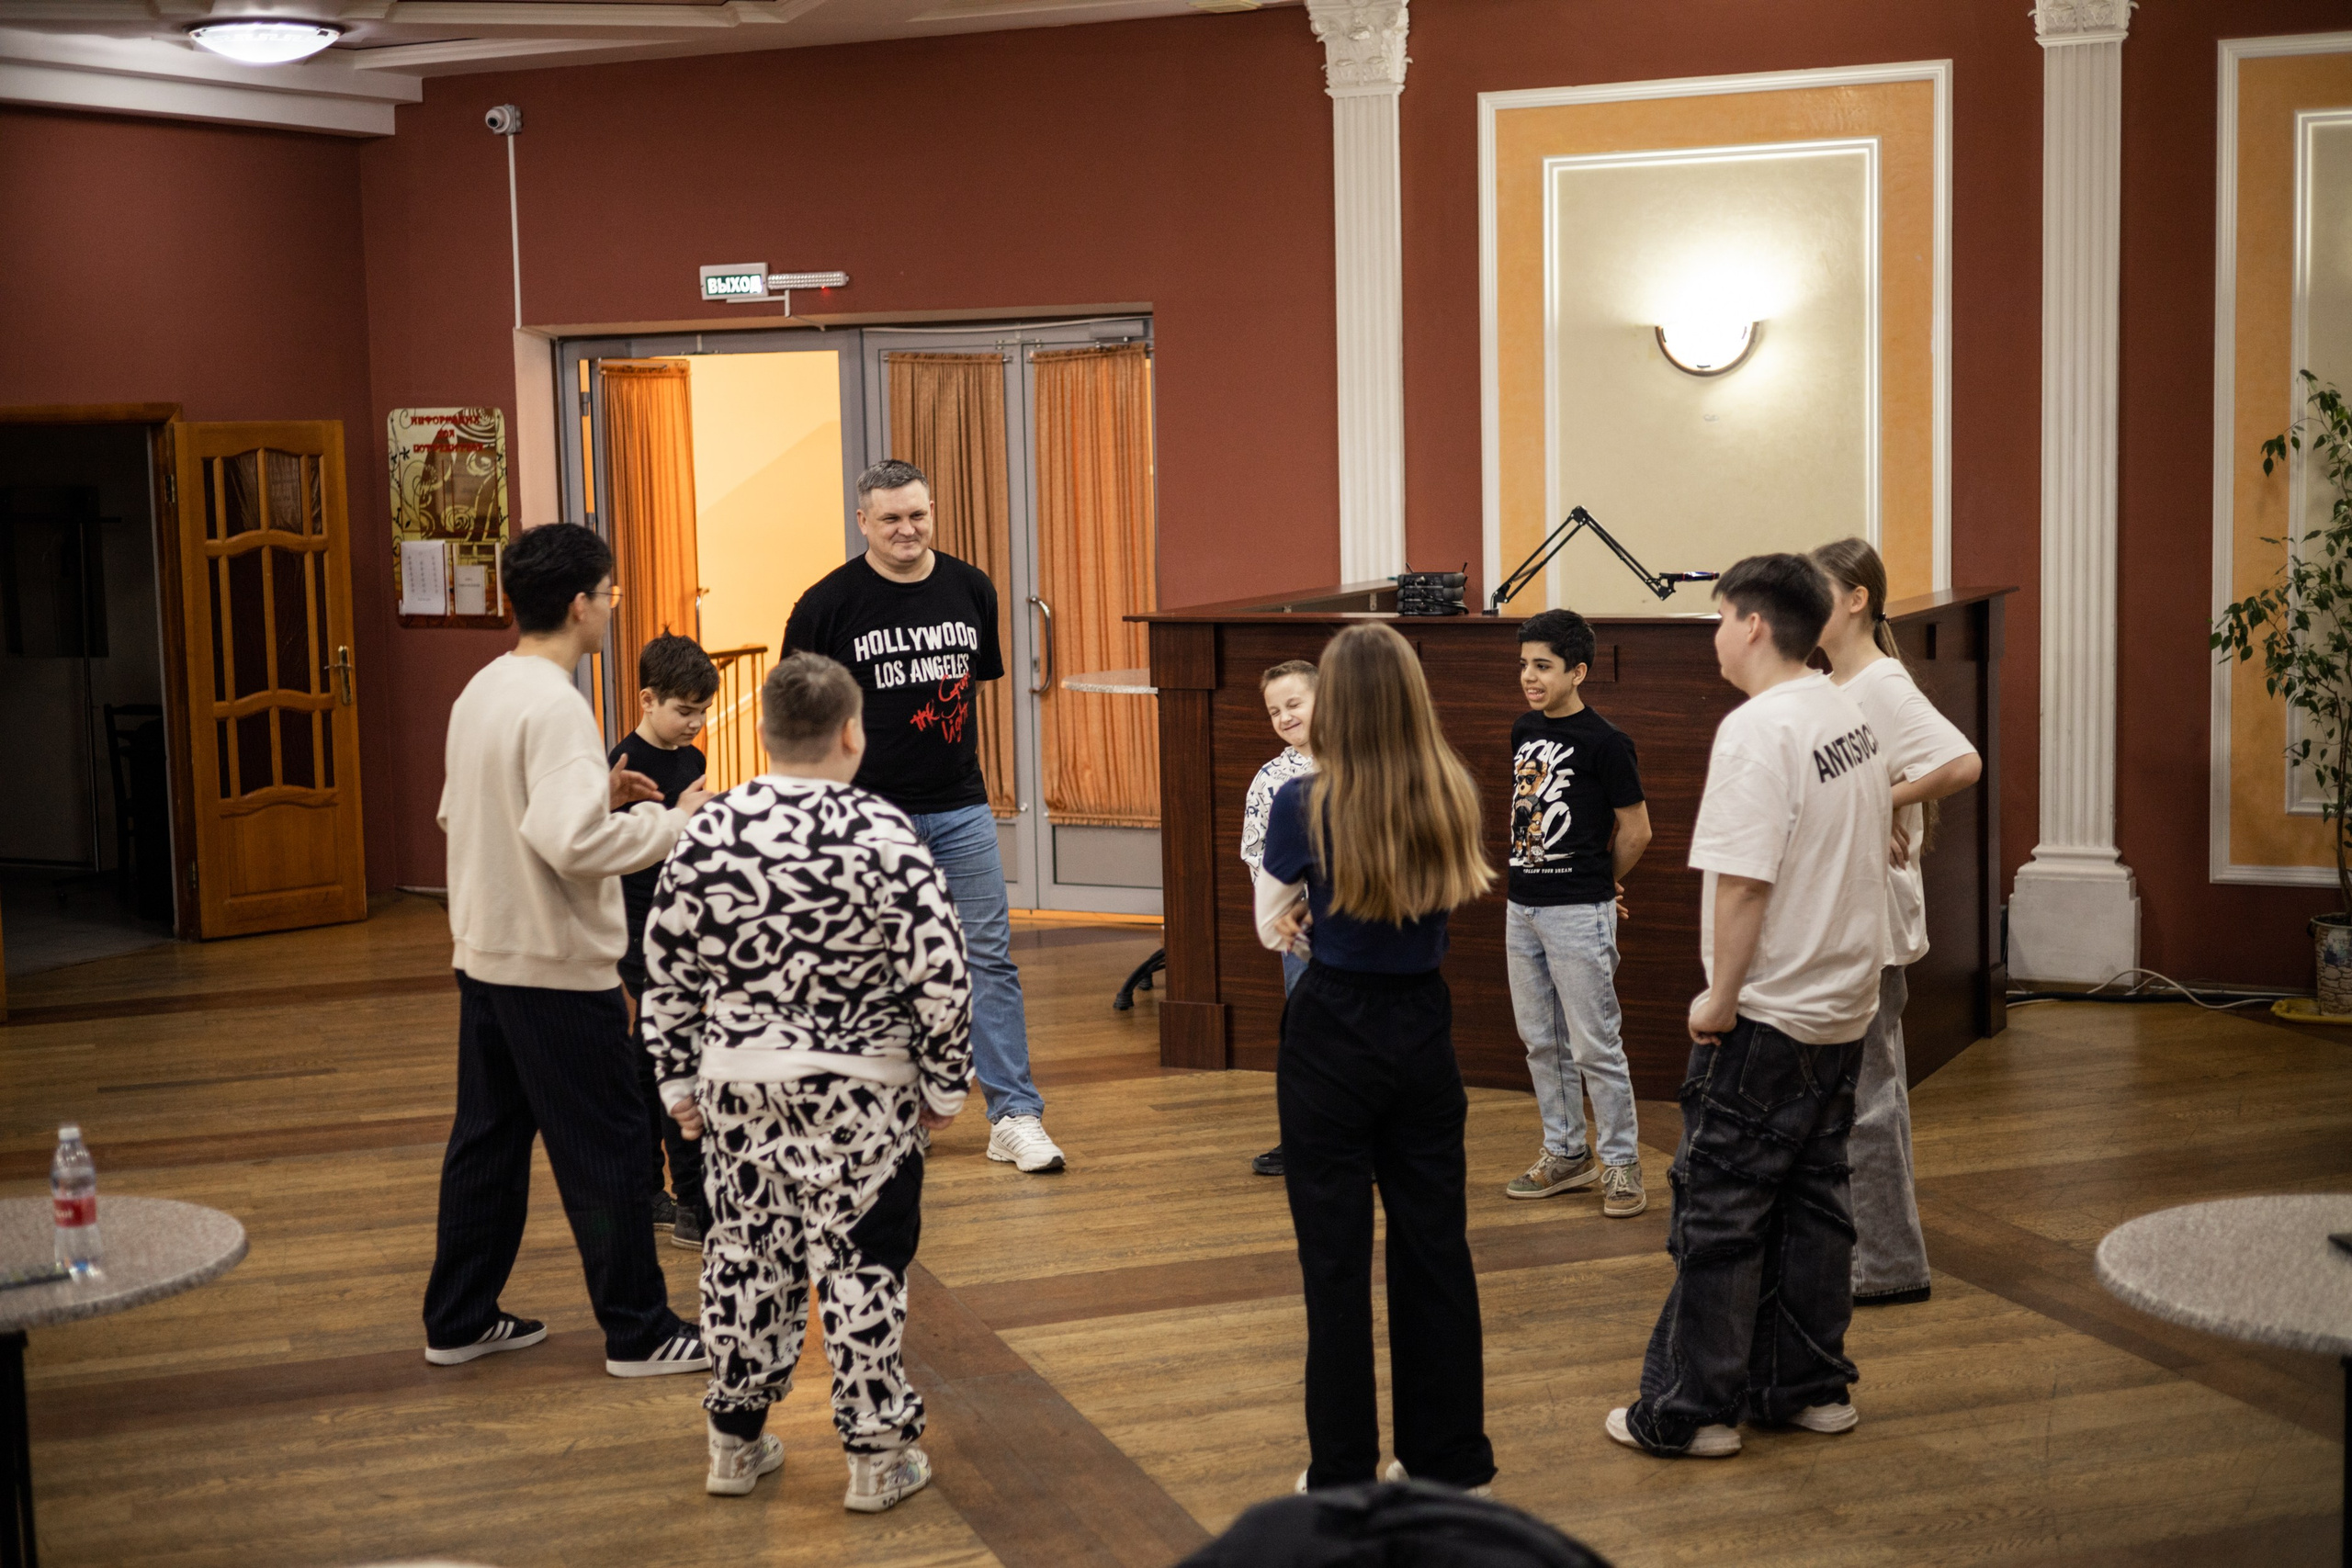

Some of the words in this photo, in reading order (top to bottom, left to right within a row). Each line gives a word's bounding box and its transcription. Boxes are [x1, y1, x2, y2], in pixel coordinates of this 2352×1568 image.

[707, 276, 763, 295] ВЫХОД
[854, 621, 978, 662] HOLLYWOOD
[875, 660, 906, 689] LOS
[910, 653, 970, 683] ANGELES
[1514, 739, 1575, 773] STAY
[1813, 722, 1879, 784] ANTISOC
